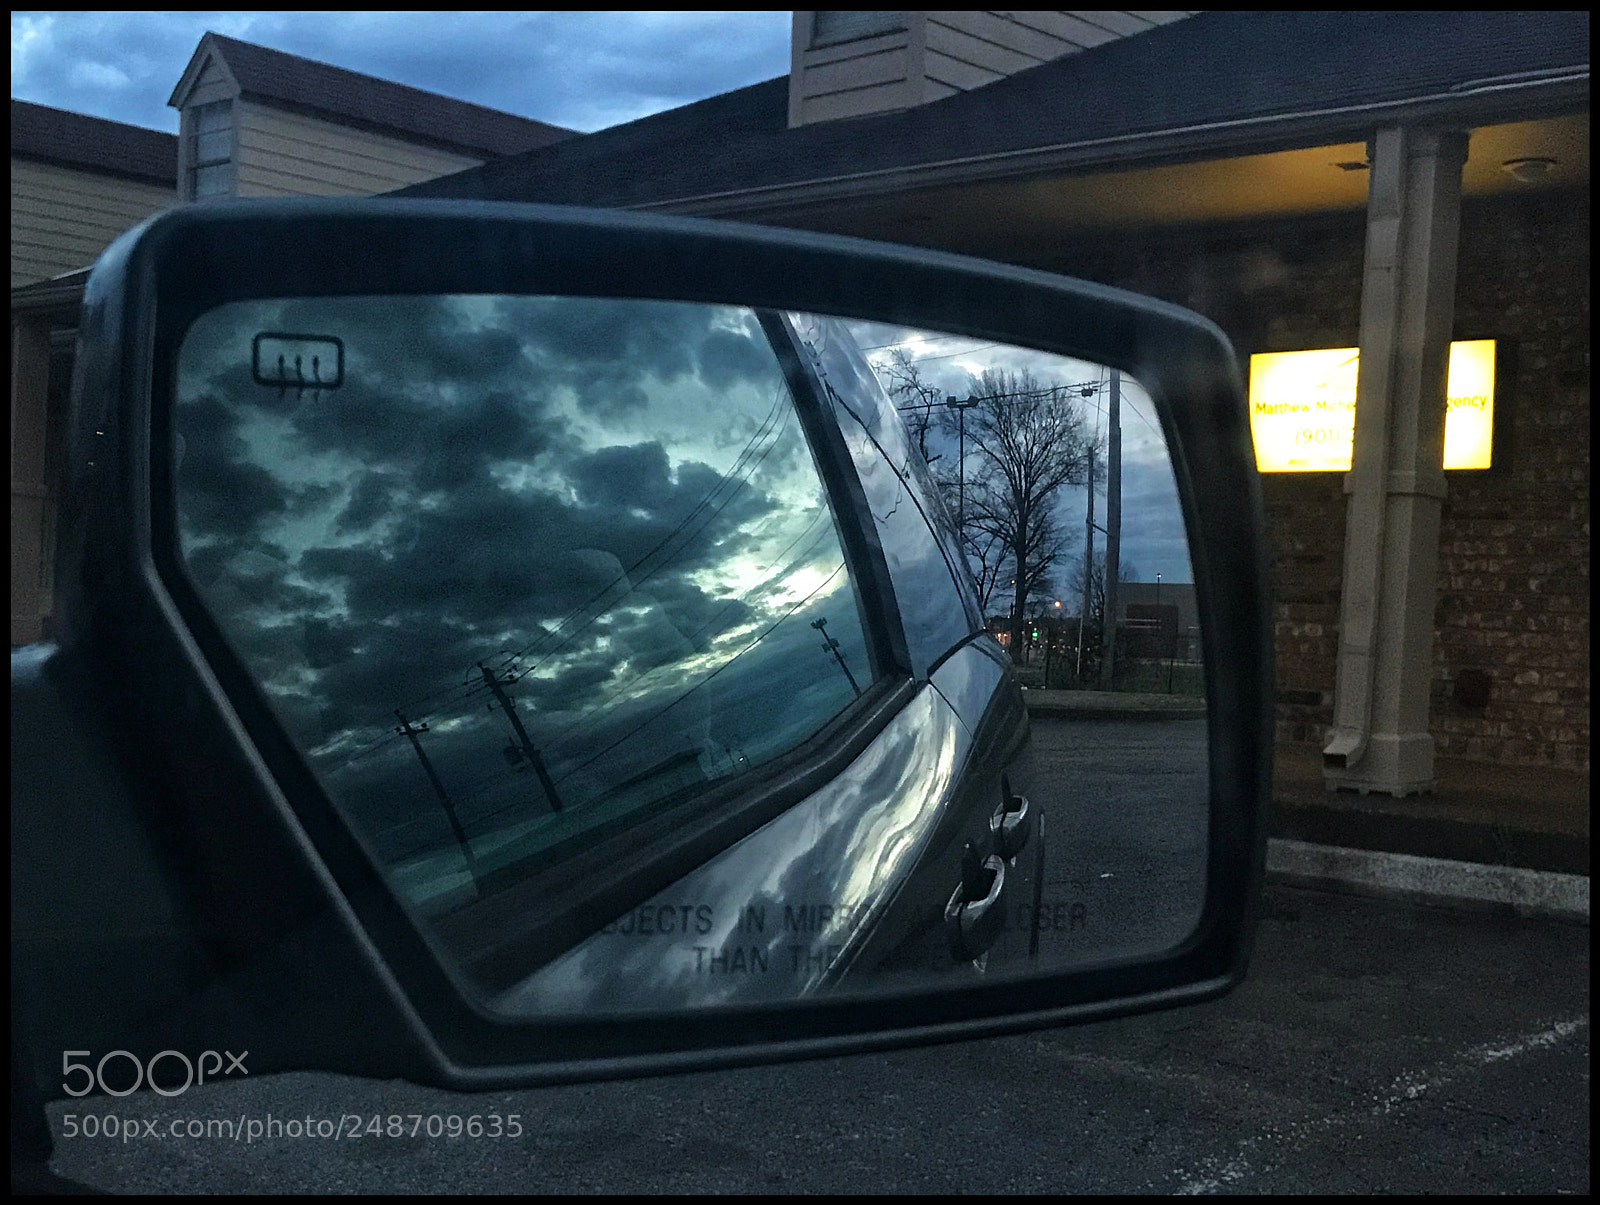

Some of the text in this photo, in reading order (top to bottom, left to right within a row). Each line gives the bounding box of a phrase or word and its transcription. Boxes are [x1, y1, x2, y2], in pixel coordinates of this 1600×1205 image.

[1255, 395, 1488, 415] Matthew Miche gency
[600, 903, 714, 935] JECTS
[738, 904, 766, 933] IN
[1002, 902, 1088, 932] LOSER
[692, 946, 769, 974] THAN
[786, 945, 843, 973] THE
